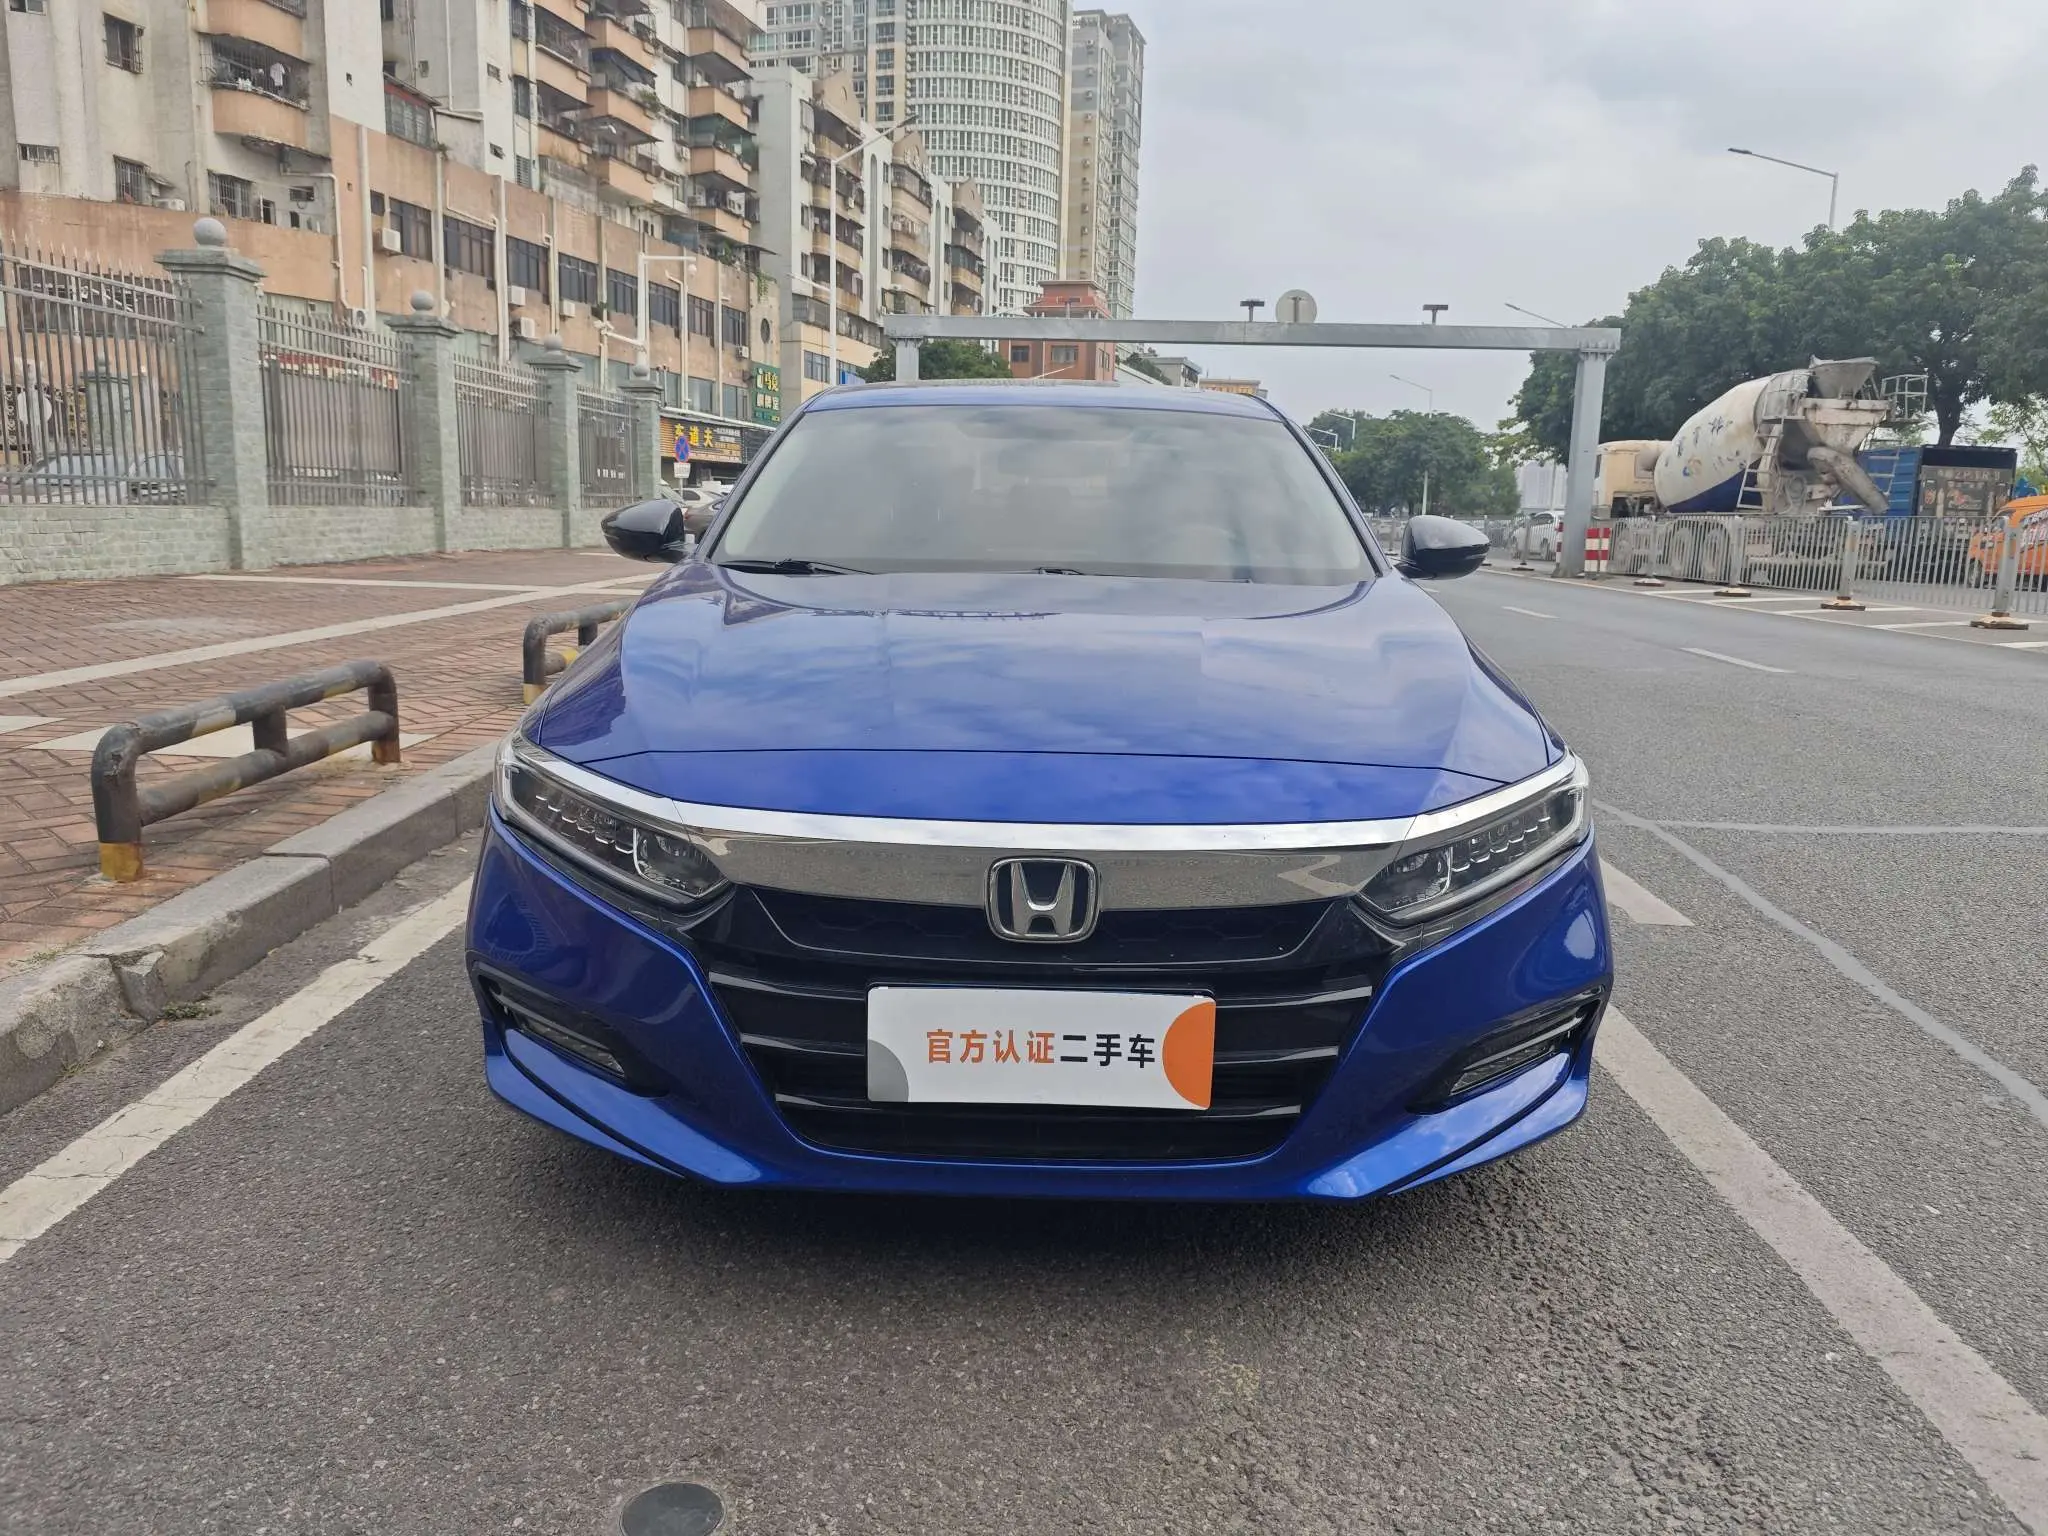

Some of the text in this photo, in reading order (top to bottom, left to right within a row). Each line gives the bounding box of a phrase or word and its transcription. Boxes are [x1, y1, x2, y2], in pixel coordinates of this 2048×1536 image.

[926, 1028, 1156, 1069] 官方认证二手车
